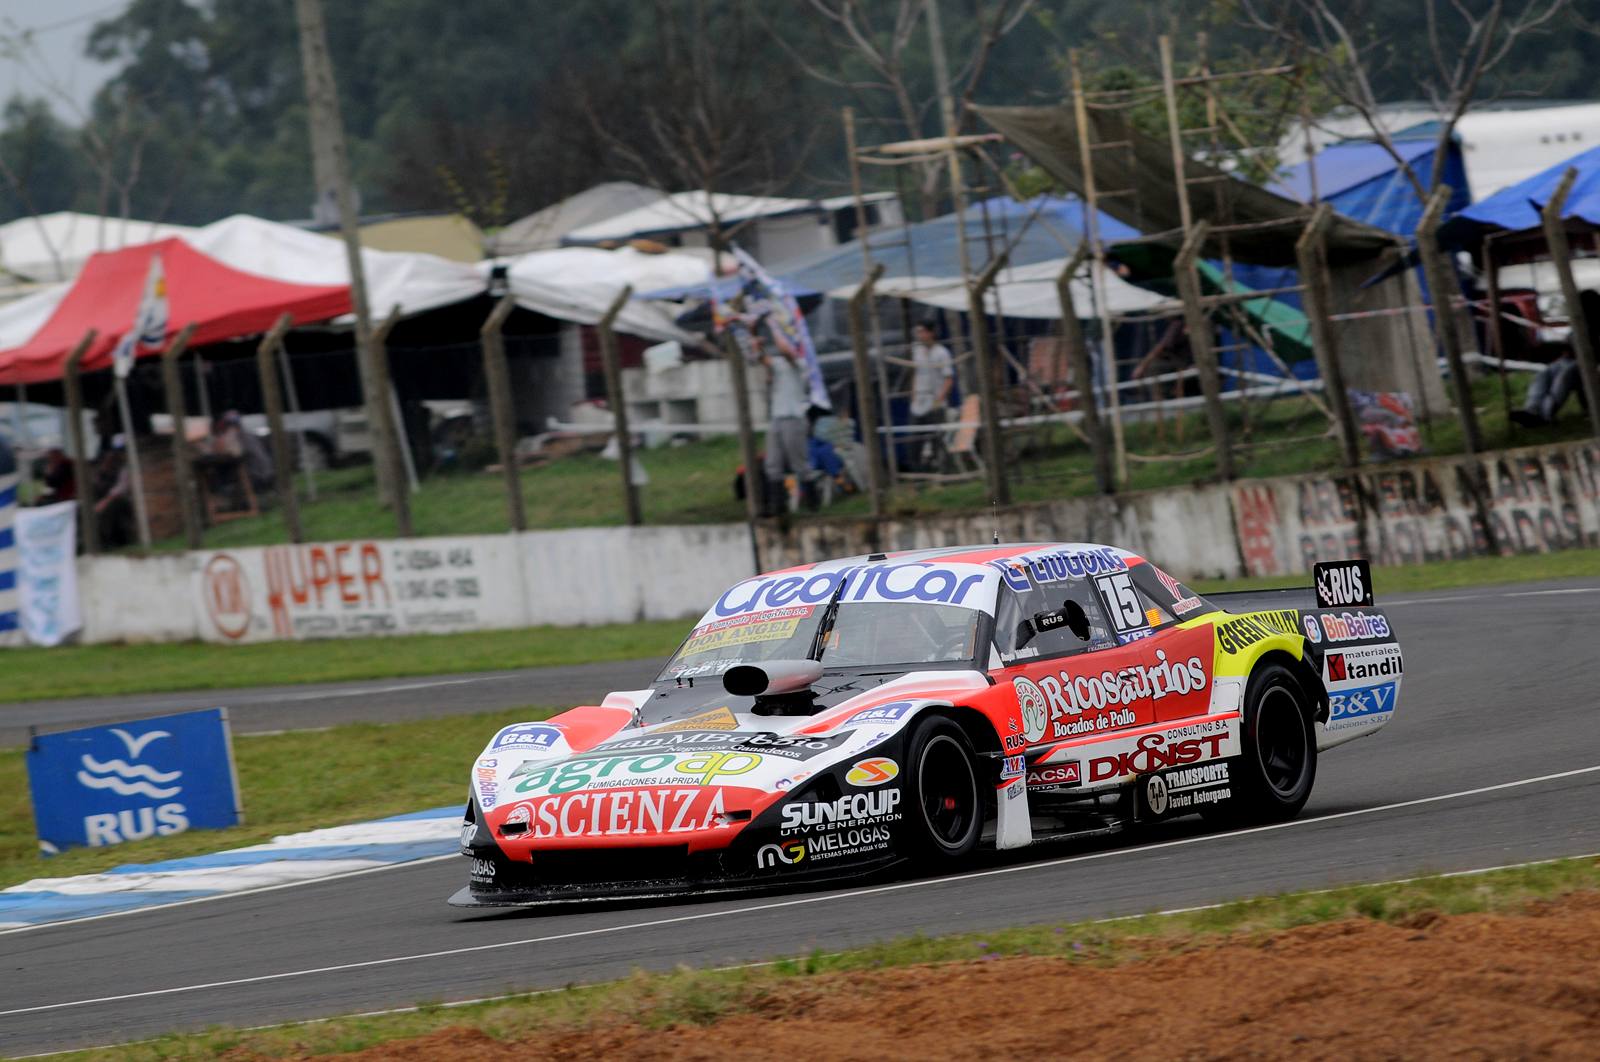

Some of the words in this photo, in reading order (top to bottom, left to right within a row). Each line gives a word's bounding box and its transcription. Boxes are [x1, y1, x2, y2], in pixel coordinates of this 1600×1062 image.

[715, 563, 984, 616] CreditCar
[1331, 566, 1363, 604] RUS
[1100, 577, 1143, 630] 15
[1042, 615, 1064, 626] RUS
[1323, 613, 1389, 638] BinBaires
[1120, 628, 1154, 643] YPF
[1217, 617, 1269, 655] GREEN
[1345, 647, 1400, 660] materiales
[1347, 656, 1403, 680] tandil
[1039, 649, 1206, 720] Ricosaurios
[1329, 686, 1393, 717] B&V
[1053, 717, 1094, 737] Bocados
[1095, 713, 1108, 728] de
[1109, 708, 1135, 727] Pollo
[1167, 722, 1212, 739] CONSULTING
[500, 733, 549, 745] G&L
[731, 744, 801, 758] Ganaderos
[1006, 733, 1025, 750] RUS
[587, 777, 657, 790] FUMIGACIONES
[658, 776, 700, 787] LAPRIDA
[1027, 767, 1077, 783] ACSA
[1166, 762, 1229, 788] TRANSPORTE
[781, 788, 900, 829] SUNEQUIP
[1168, 794, 1192, 809] Javier
[1193, 788, 1231, 804] Astorgano
[535, 787, 731, 838] SCIENZA
[780, 825, 811, 836] UTV
[815, 813, 902, 832] GENERATION
[84, 803, 190, 847] RUS
[808, 825, 891, 854] MELOGAS
[810, 850, 842, 861] SISTEMAS
[843, 847, 859, 856] PARA
[859, 845, 874, 853] AGUA
